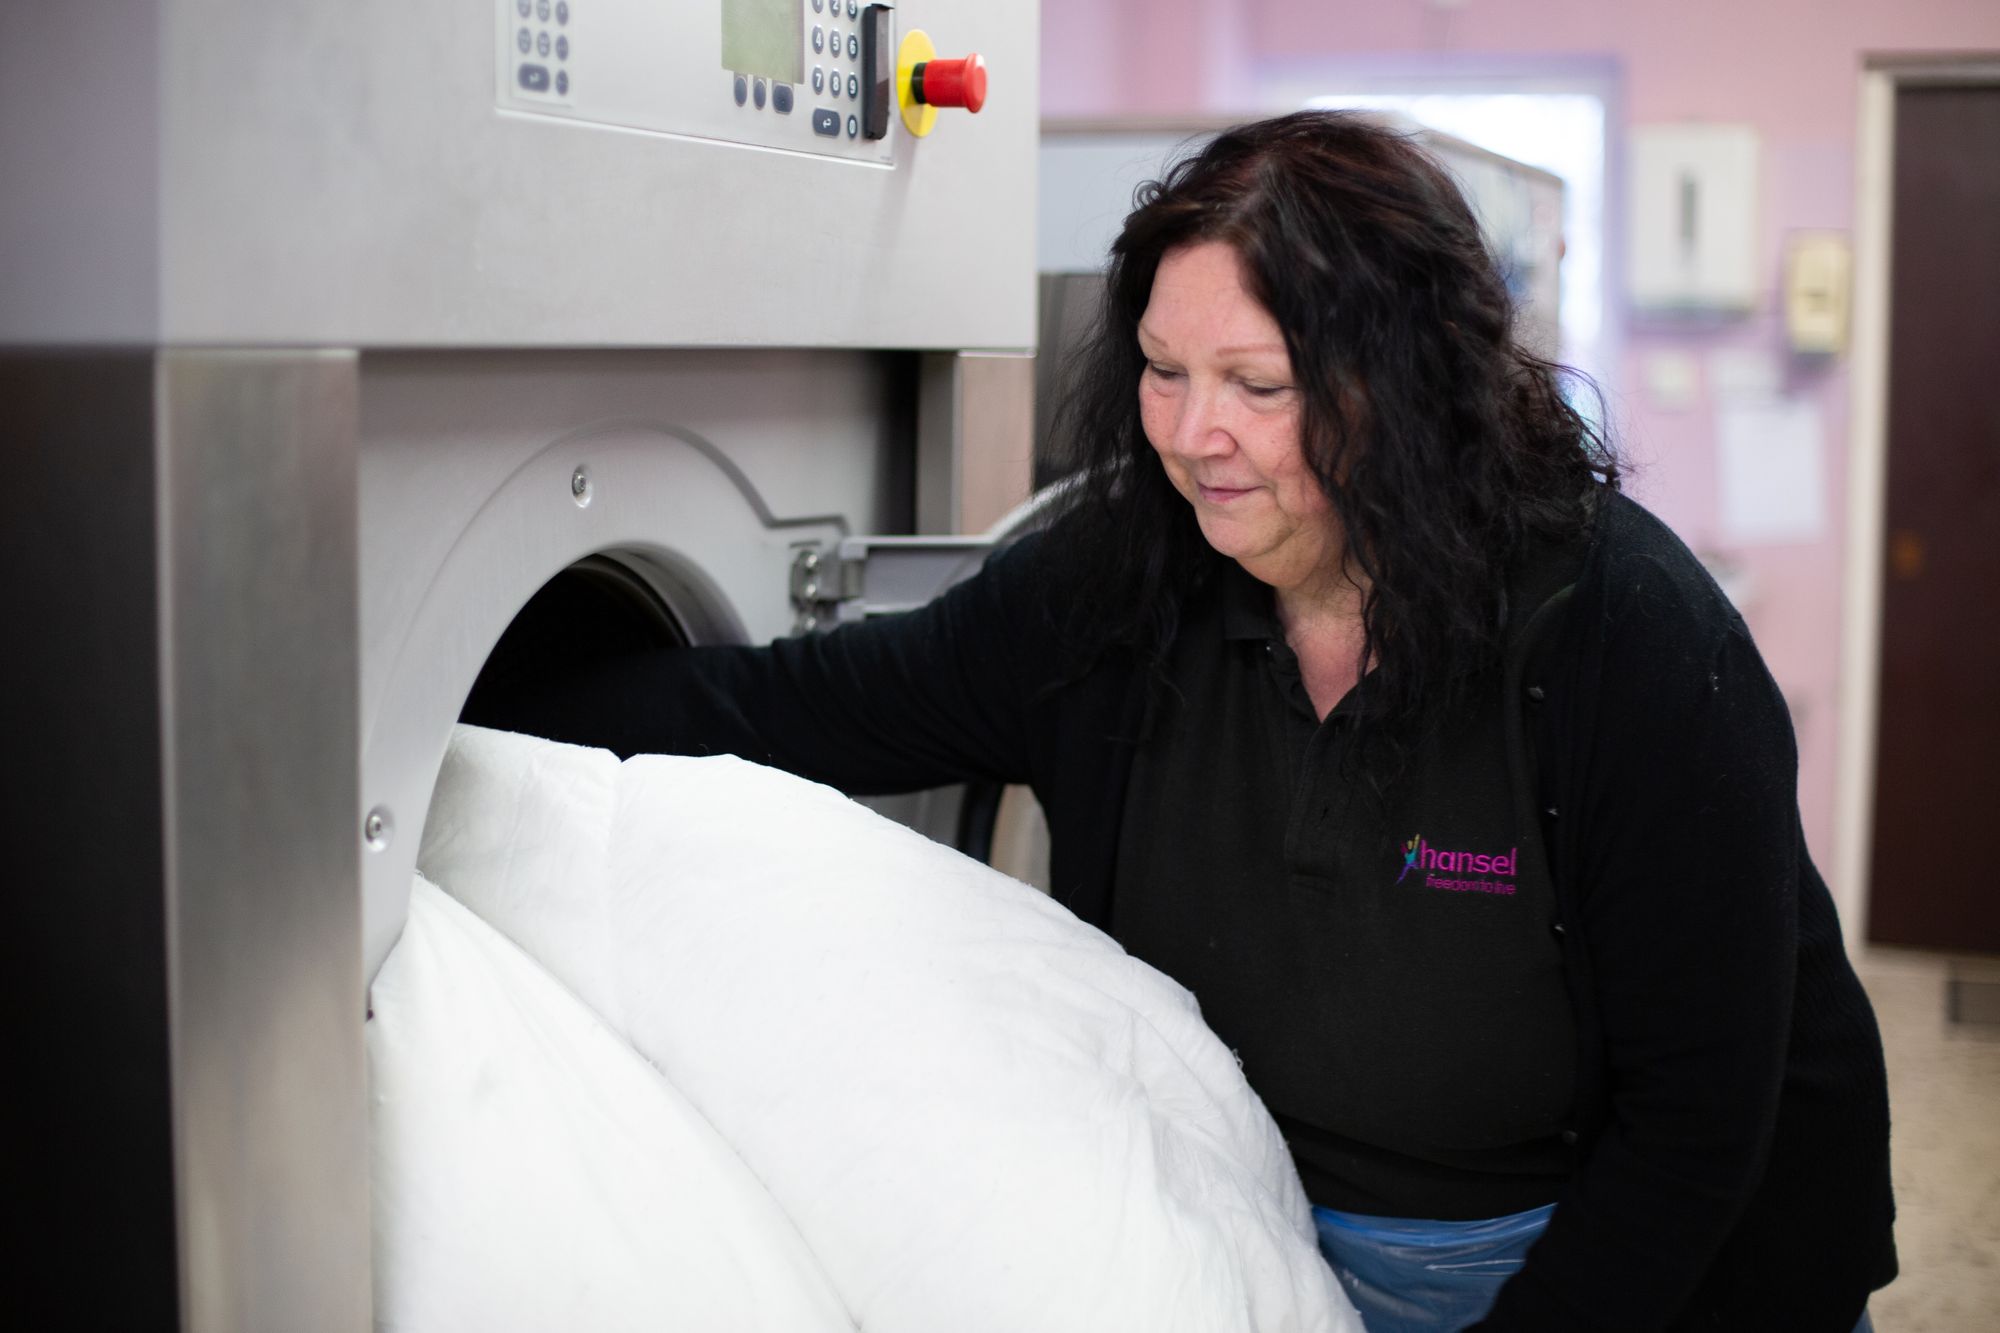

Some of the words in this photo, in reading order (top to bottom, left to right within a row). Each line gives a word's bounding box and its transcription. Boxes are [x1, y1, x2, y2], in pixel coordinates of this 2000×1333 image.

[815, 31, 822, 47] 4
[832, 36, 839, 51] 5
[849, 39, 856, 55] 6
[815, 72, 822, 88] 7
[832, 76, 839, 91] 8
[849, 79, 856, 95] 9
[1420, 839, 1517, 876] hansel
